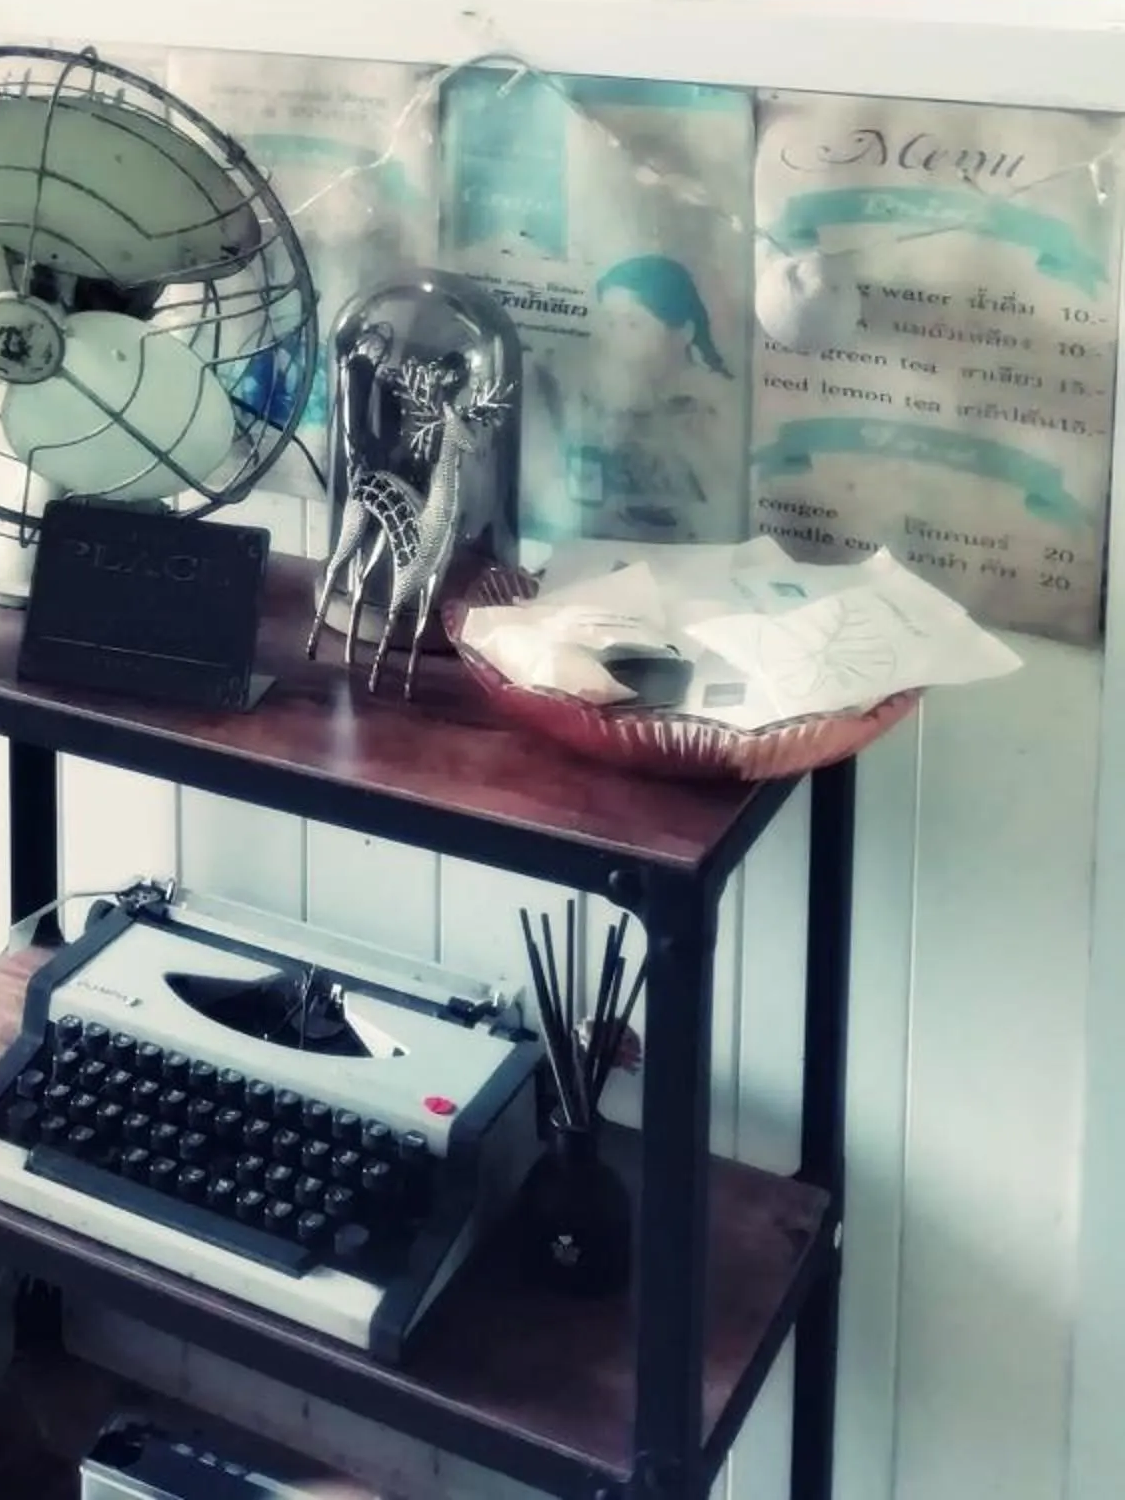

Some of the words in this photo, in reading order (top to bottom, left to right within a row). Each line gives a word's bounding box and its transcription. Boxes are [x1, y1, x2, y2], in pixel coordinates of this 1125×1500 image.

[781, 129, 1024, 179] Menu
[882, 286, 952, 306] water
[820, 347, 888, 368] green
[900, 355, 938, 375] tea
[763, 374, 809, 393] iced
[821, 380, 893, 405] lemon
[904, 395, 942, 415] tea
[757, 497, 839, 520] congee
[758, 520, 836, 547] noodle
